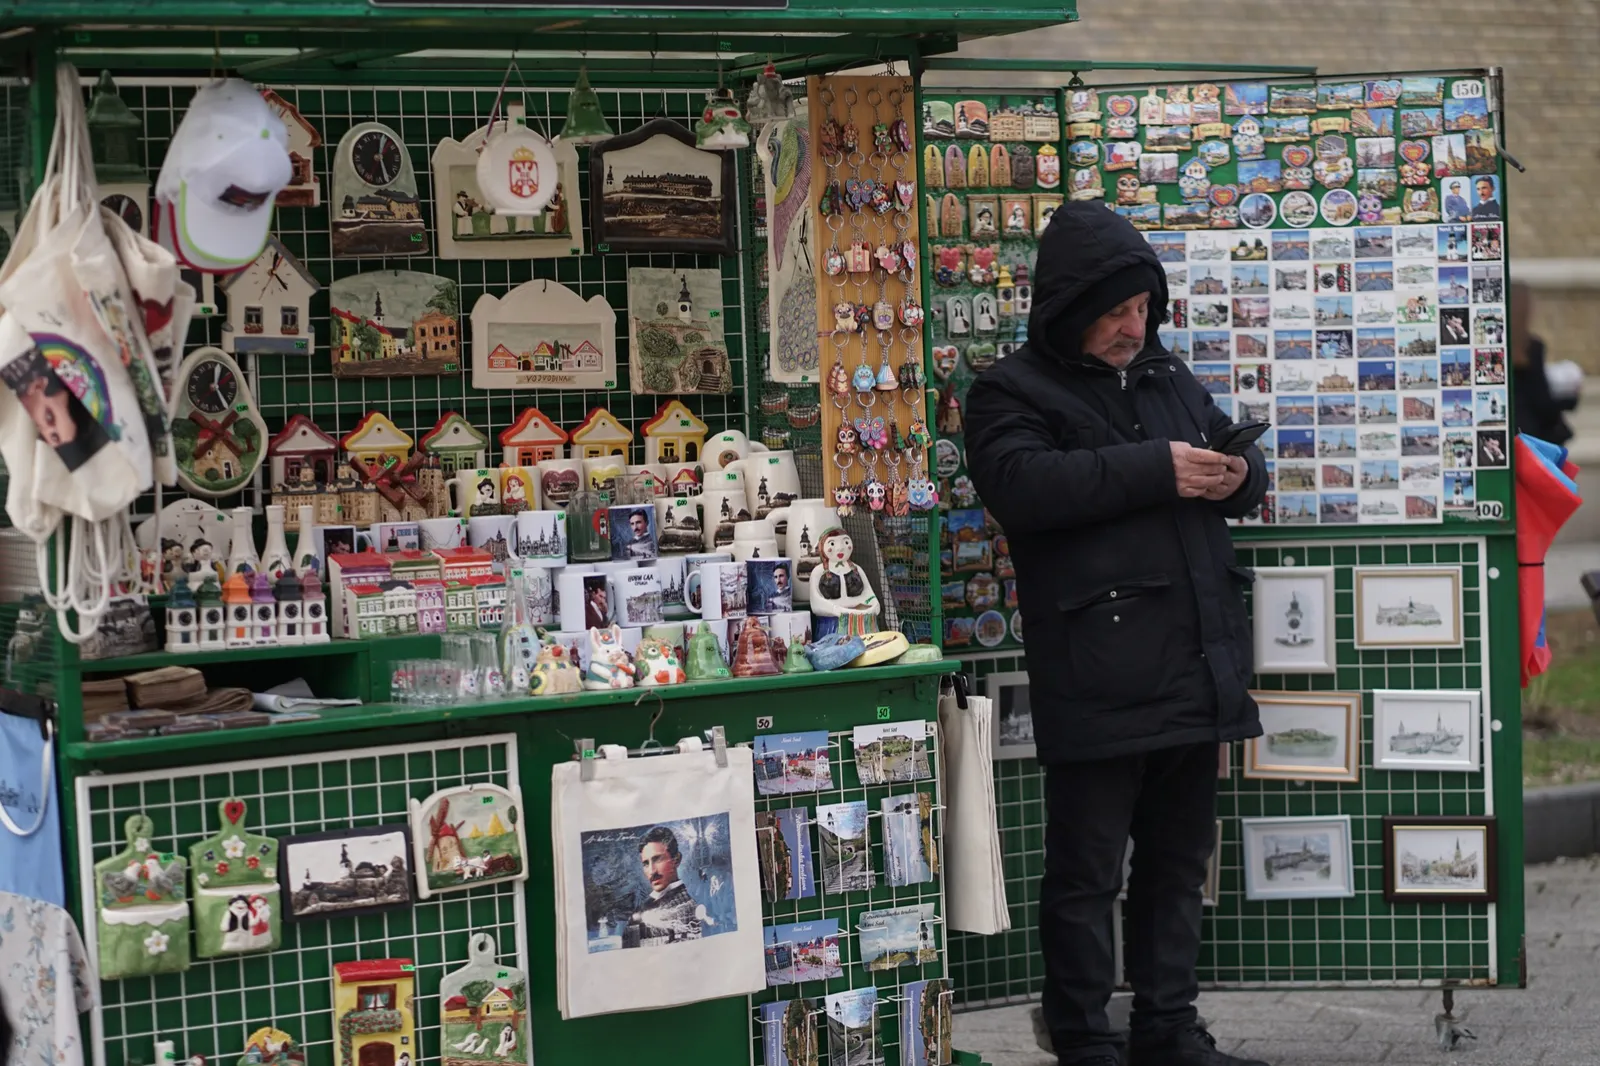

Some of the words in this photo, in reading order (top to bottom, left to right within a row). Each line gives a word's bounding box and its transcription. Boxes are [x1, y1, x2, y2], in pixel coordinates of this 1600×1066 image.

[1456, 83, 1479, 96] 150
[526, 374, 567, 384] VOJVODINA
[878, 708, 888, 718] 50
[758, 718, 770, 729] 50
